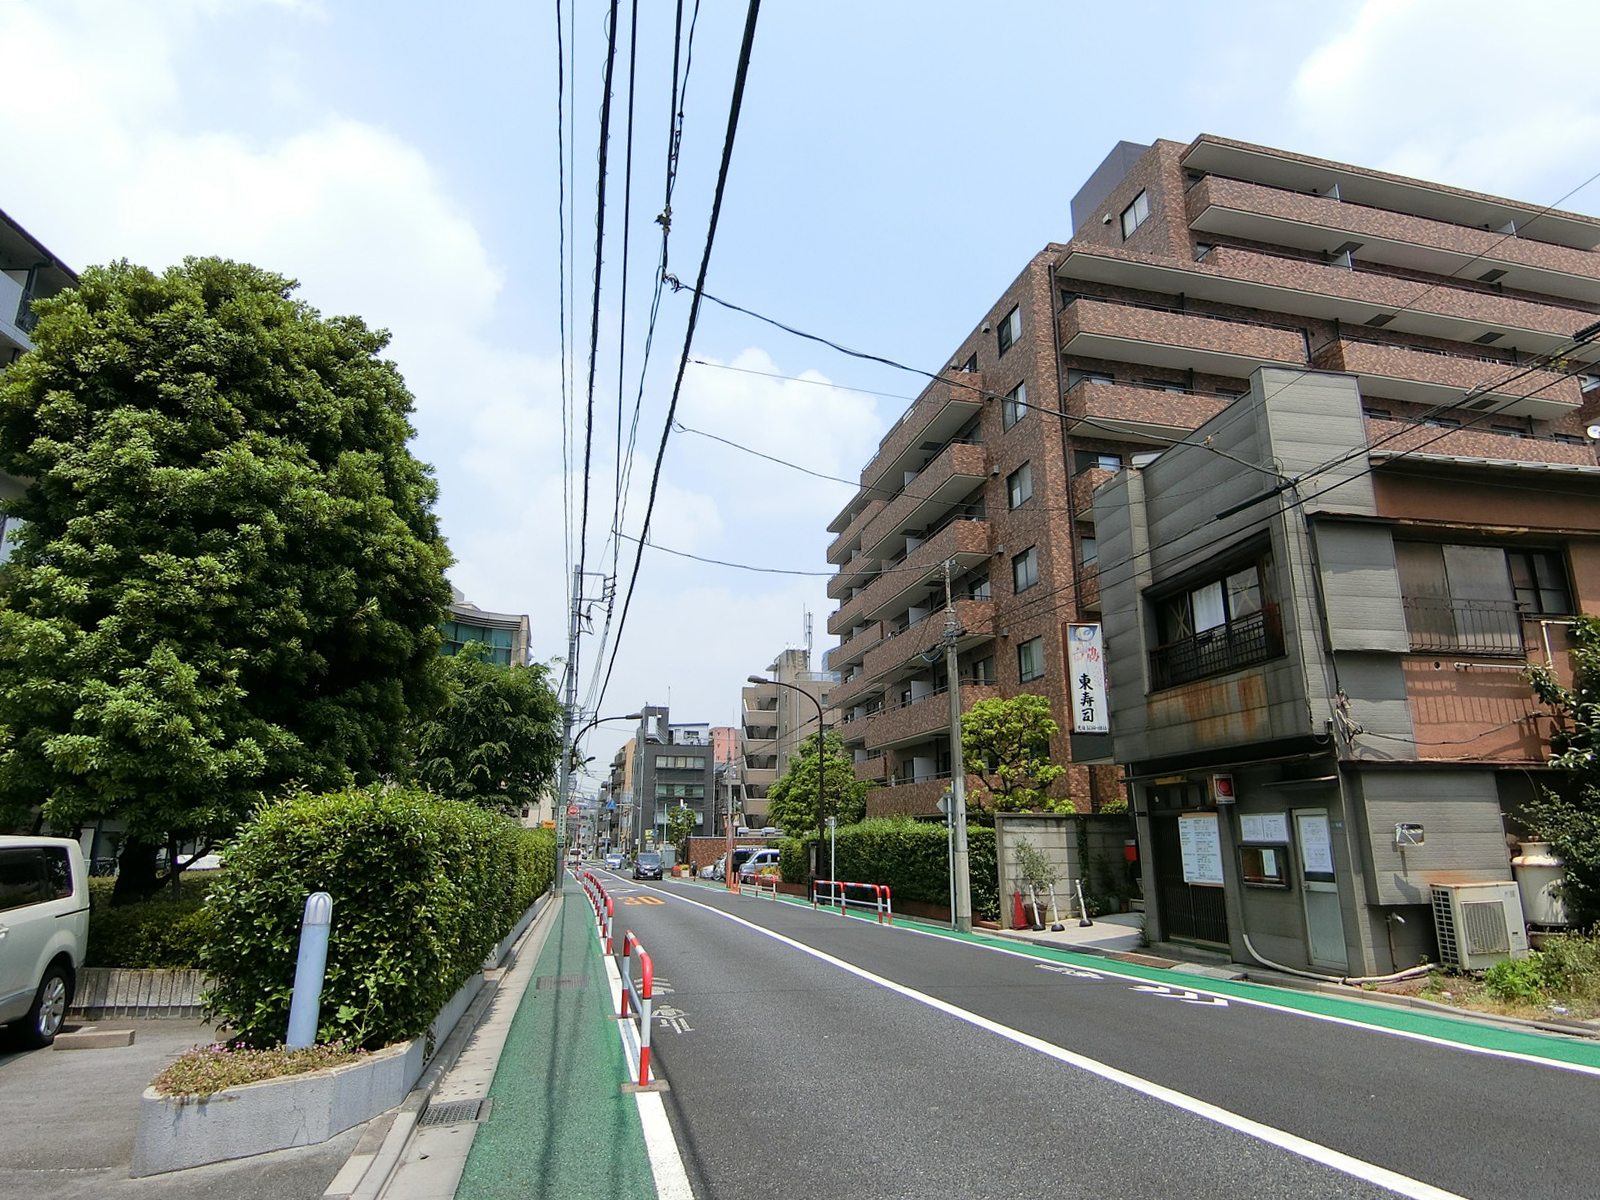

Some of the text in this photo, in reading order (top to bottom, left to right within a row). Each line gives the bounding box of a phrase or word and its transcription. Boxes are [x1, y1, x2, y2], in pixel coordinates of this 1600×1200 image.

[1078, 673, 1095, 722] 東寿司
[617, 896, 666, 906] 30
